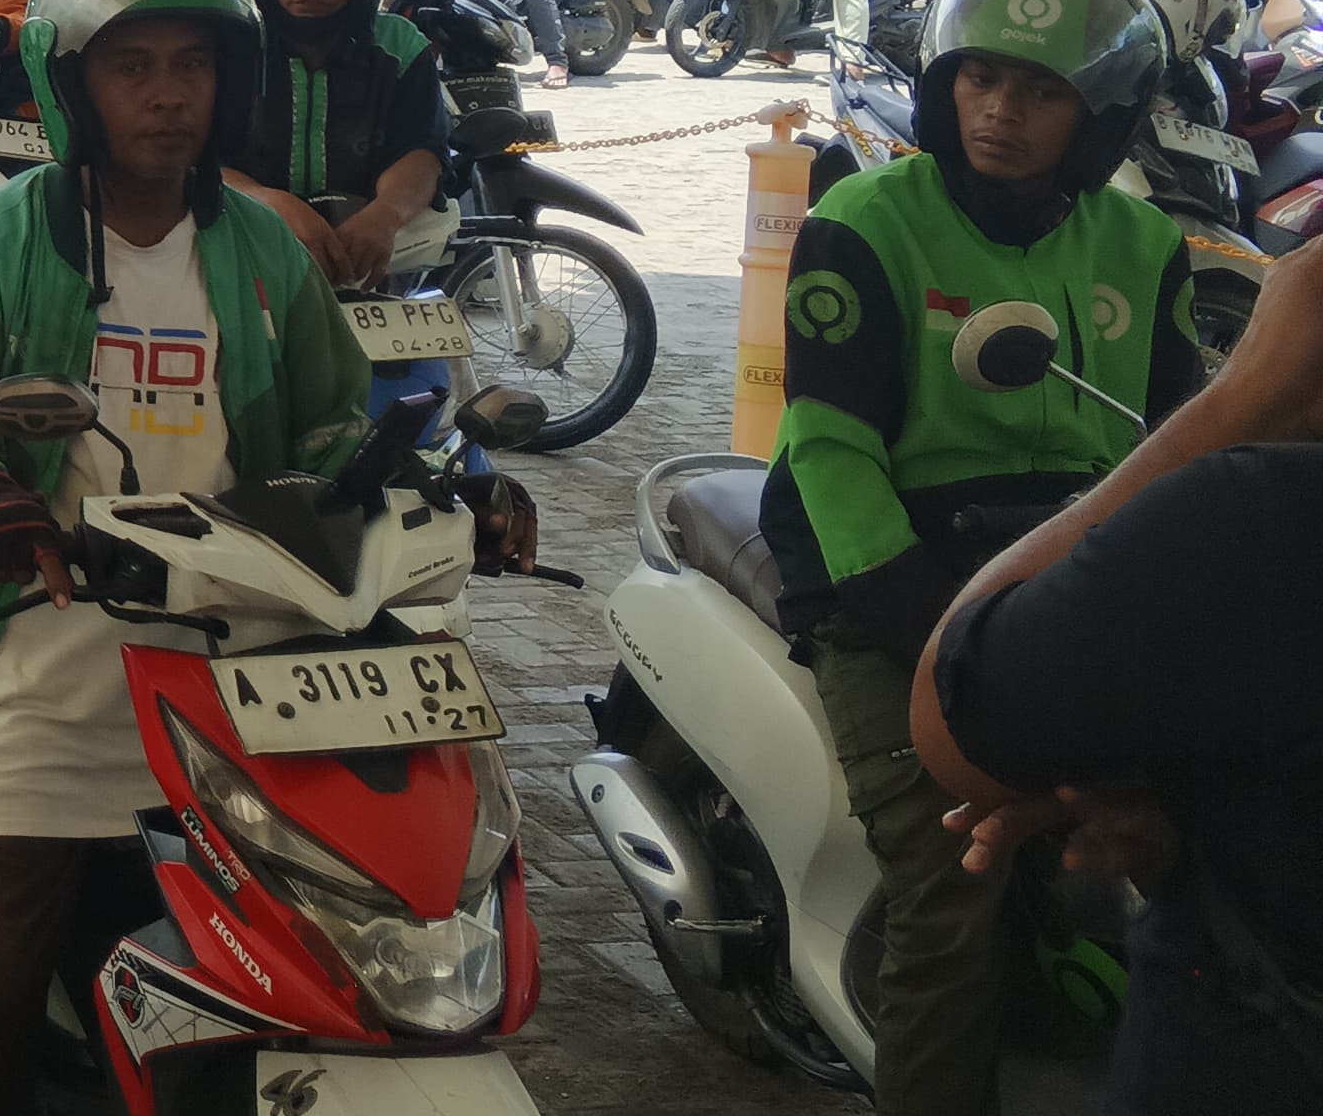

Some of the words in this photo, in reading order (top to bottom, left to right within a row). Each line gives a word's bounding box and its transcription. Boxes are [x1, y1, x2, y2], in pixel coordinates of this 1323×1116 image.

[234, 668, 263, 707] A
[291, 661, 388, 702] 3119
[410, 652, 467, 693] CX
[209, 910, 274, 997] HONDA
